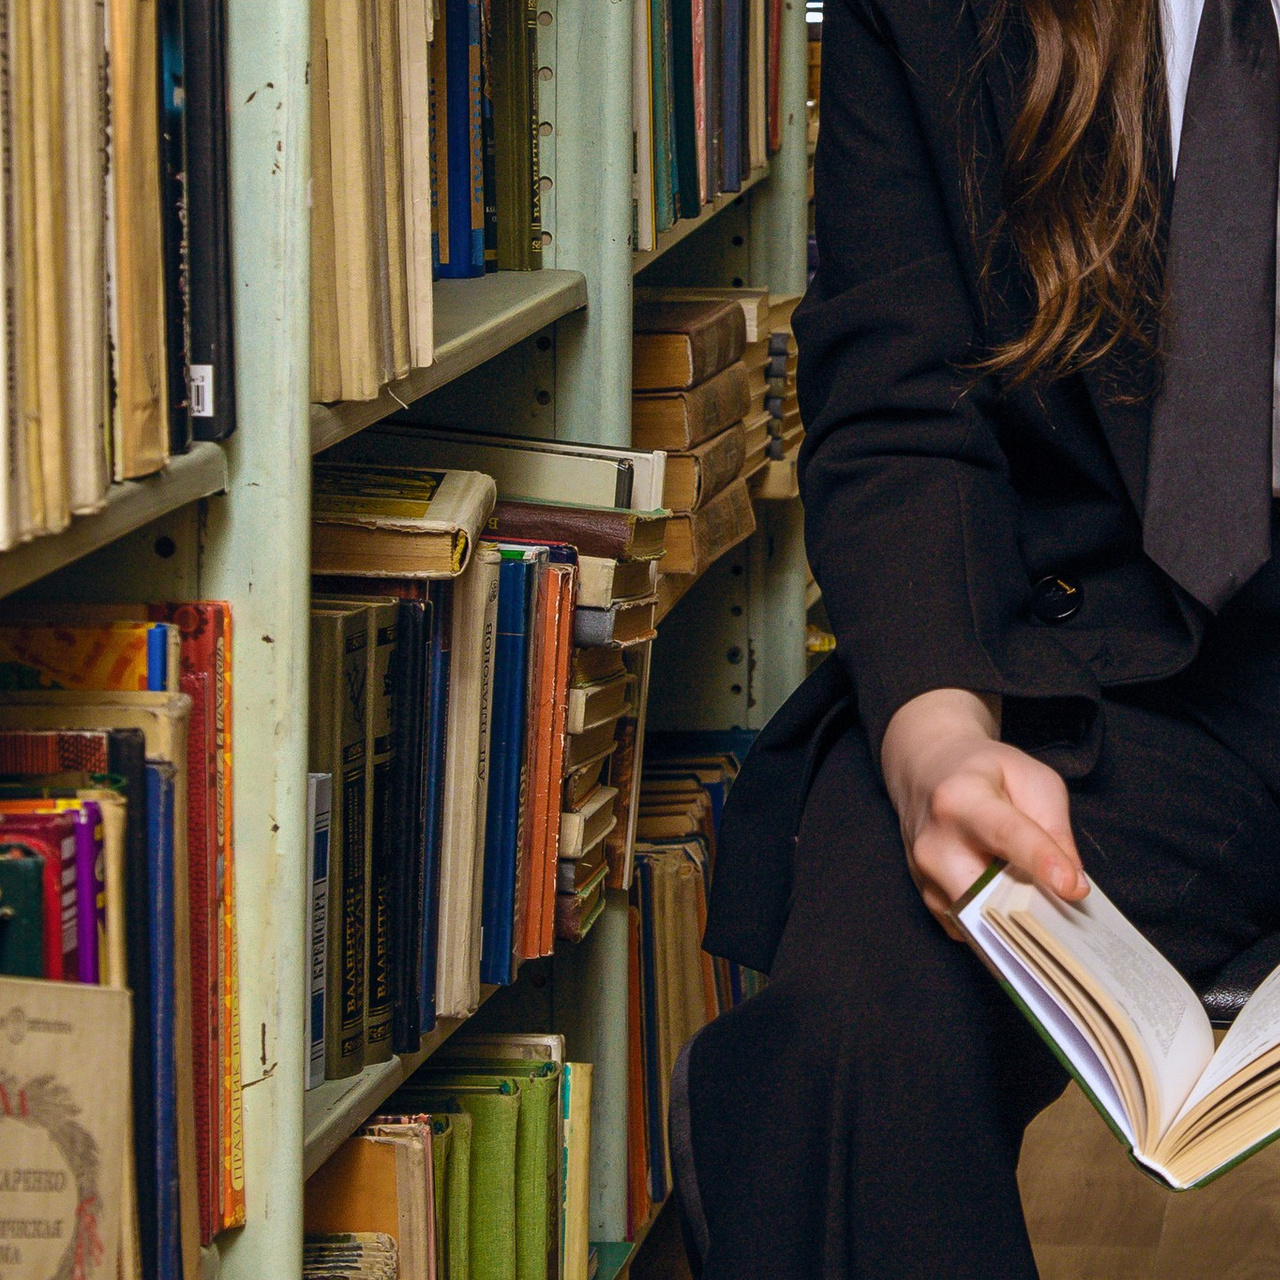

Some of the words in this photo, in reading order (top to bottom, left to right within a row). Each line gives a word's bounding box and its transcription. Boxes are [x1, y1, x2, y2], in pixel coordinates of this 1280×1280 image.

[480, 621, 492, 734] ПЛАТОНОВ
[346, 887, 357, 1014] ВАЛЕНТИН
[377, 878, 386, 1000] ВАЛЕНТИН
